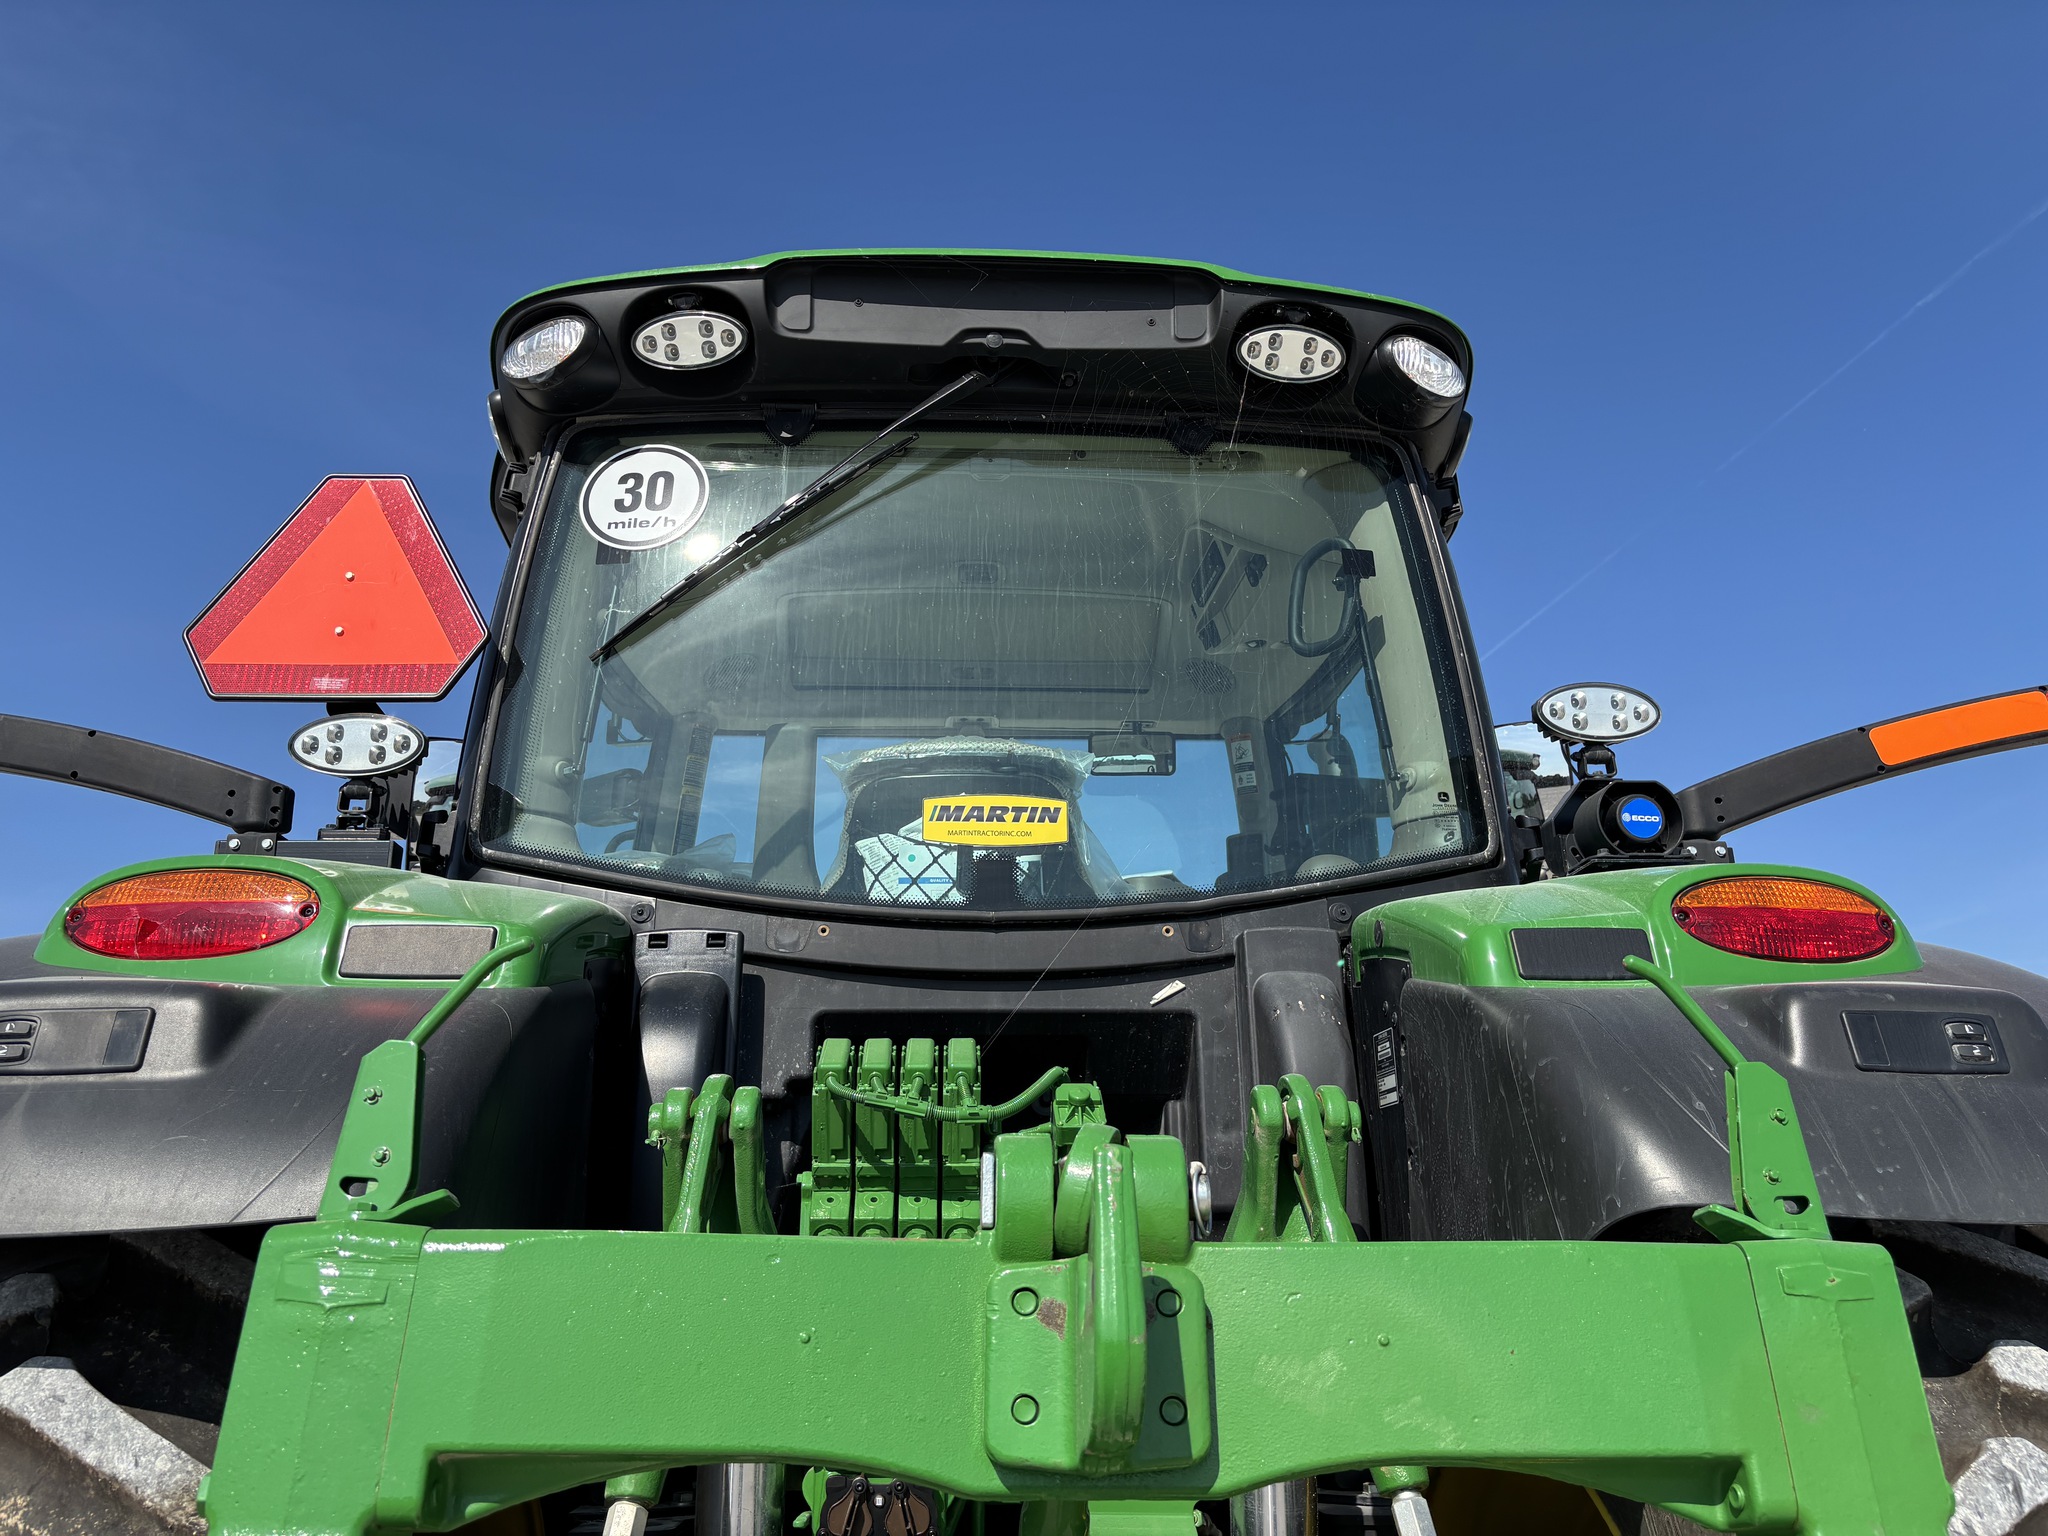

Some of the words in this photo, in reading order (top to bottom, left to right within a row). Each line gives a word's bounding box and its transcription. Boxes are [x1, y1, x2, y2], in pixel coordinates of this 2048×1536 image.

[614, 470, 675, 513] 30
[607, 516, 677, 530] mile/h
[937, 805, 1062, 824] MARTIN
[947, 829, 1033, 838] MARTINTRACTORINC.COM
